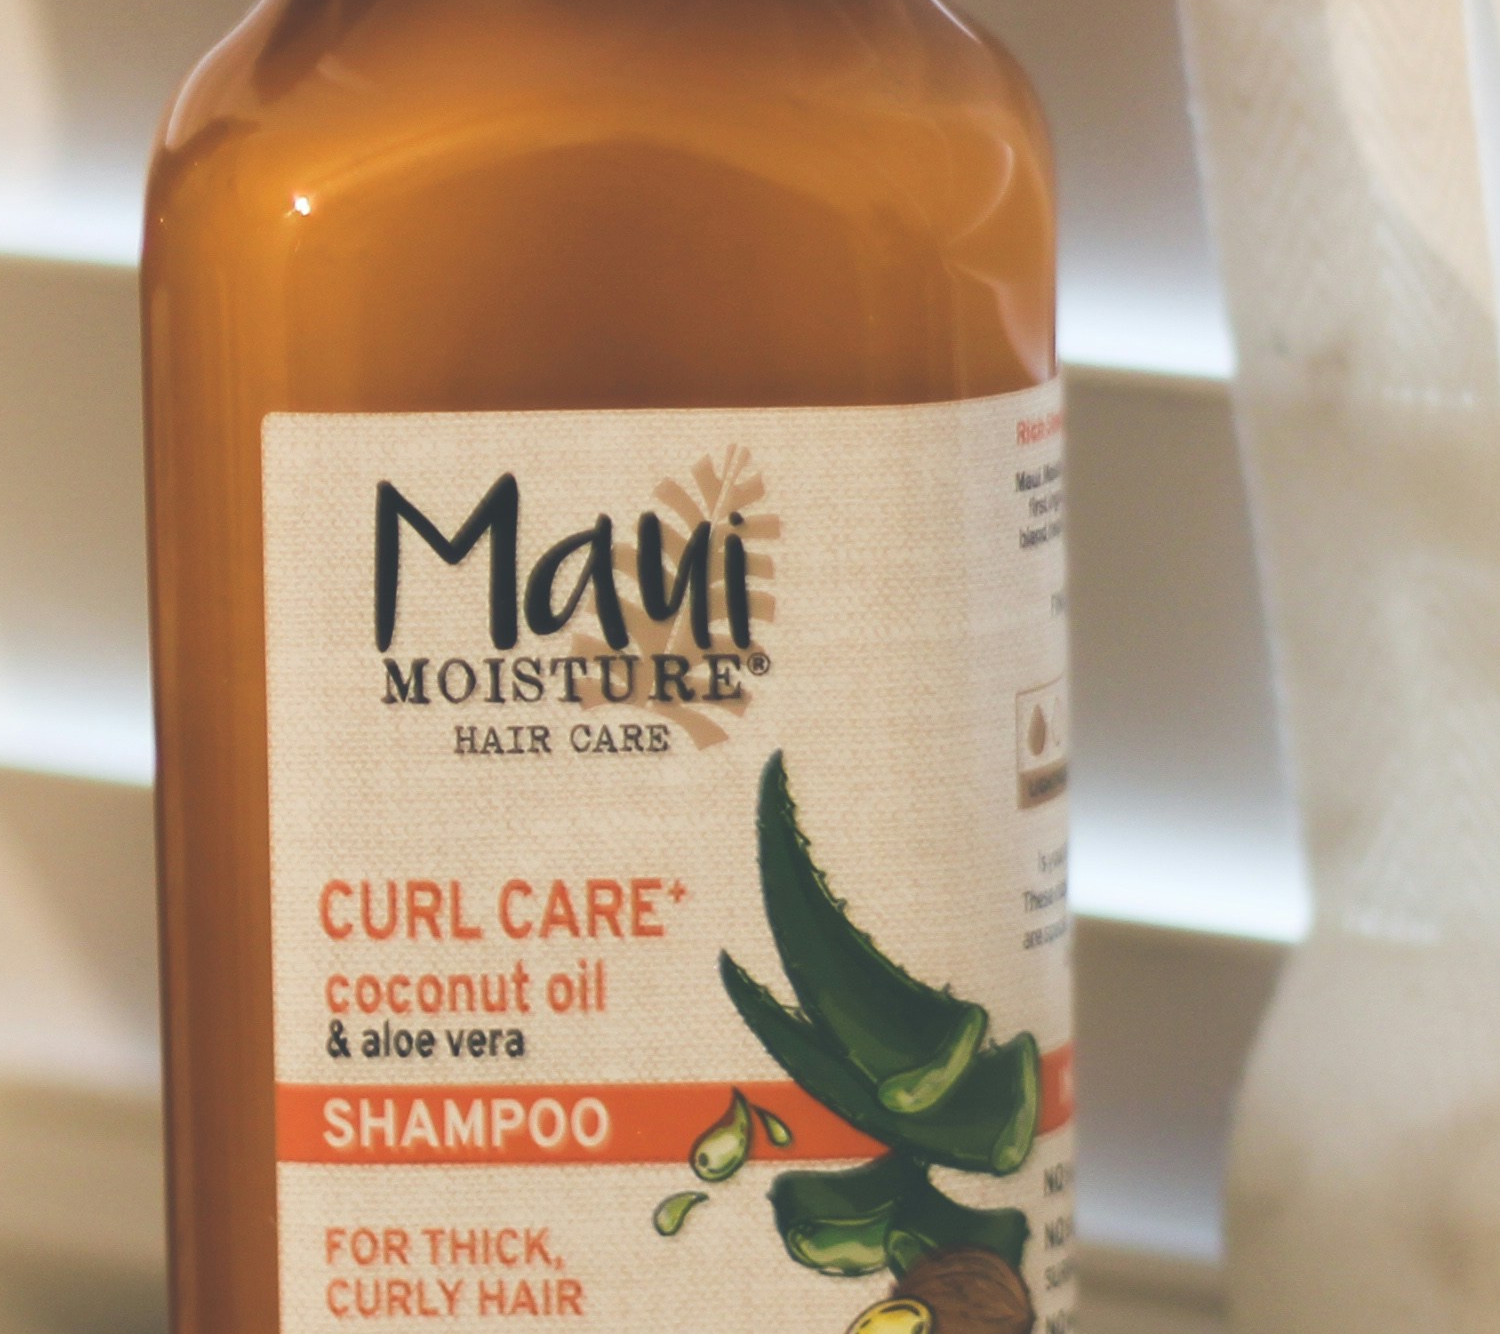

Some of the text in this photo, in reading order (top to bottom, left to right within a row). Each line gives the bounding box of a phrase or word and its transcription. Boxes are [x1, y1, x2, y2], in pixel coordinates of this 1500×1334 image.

[374, 472, 752, 653] Maui
[454, 724, 672, 755] HAIR CARE
[319, 880, 482, 941] CURL
[324, 959, 608, 1014] coconut oil
[326, 1020, 525, 1058] & aloe vera
[323, 1096, 611, 1148] SHAMPOO
[324, 1226, 565, 1268] FOR THICK,
[325, 1278, 584, 1318] CURLY HAIR
